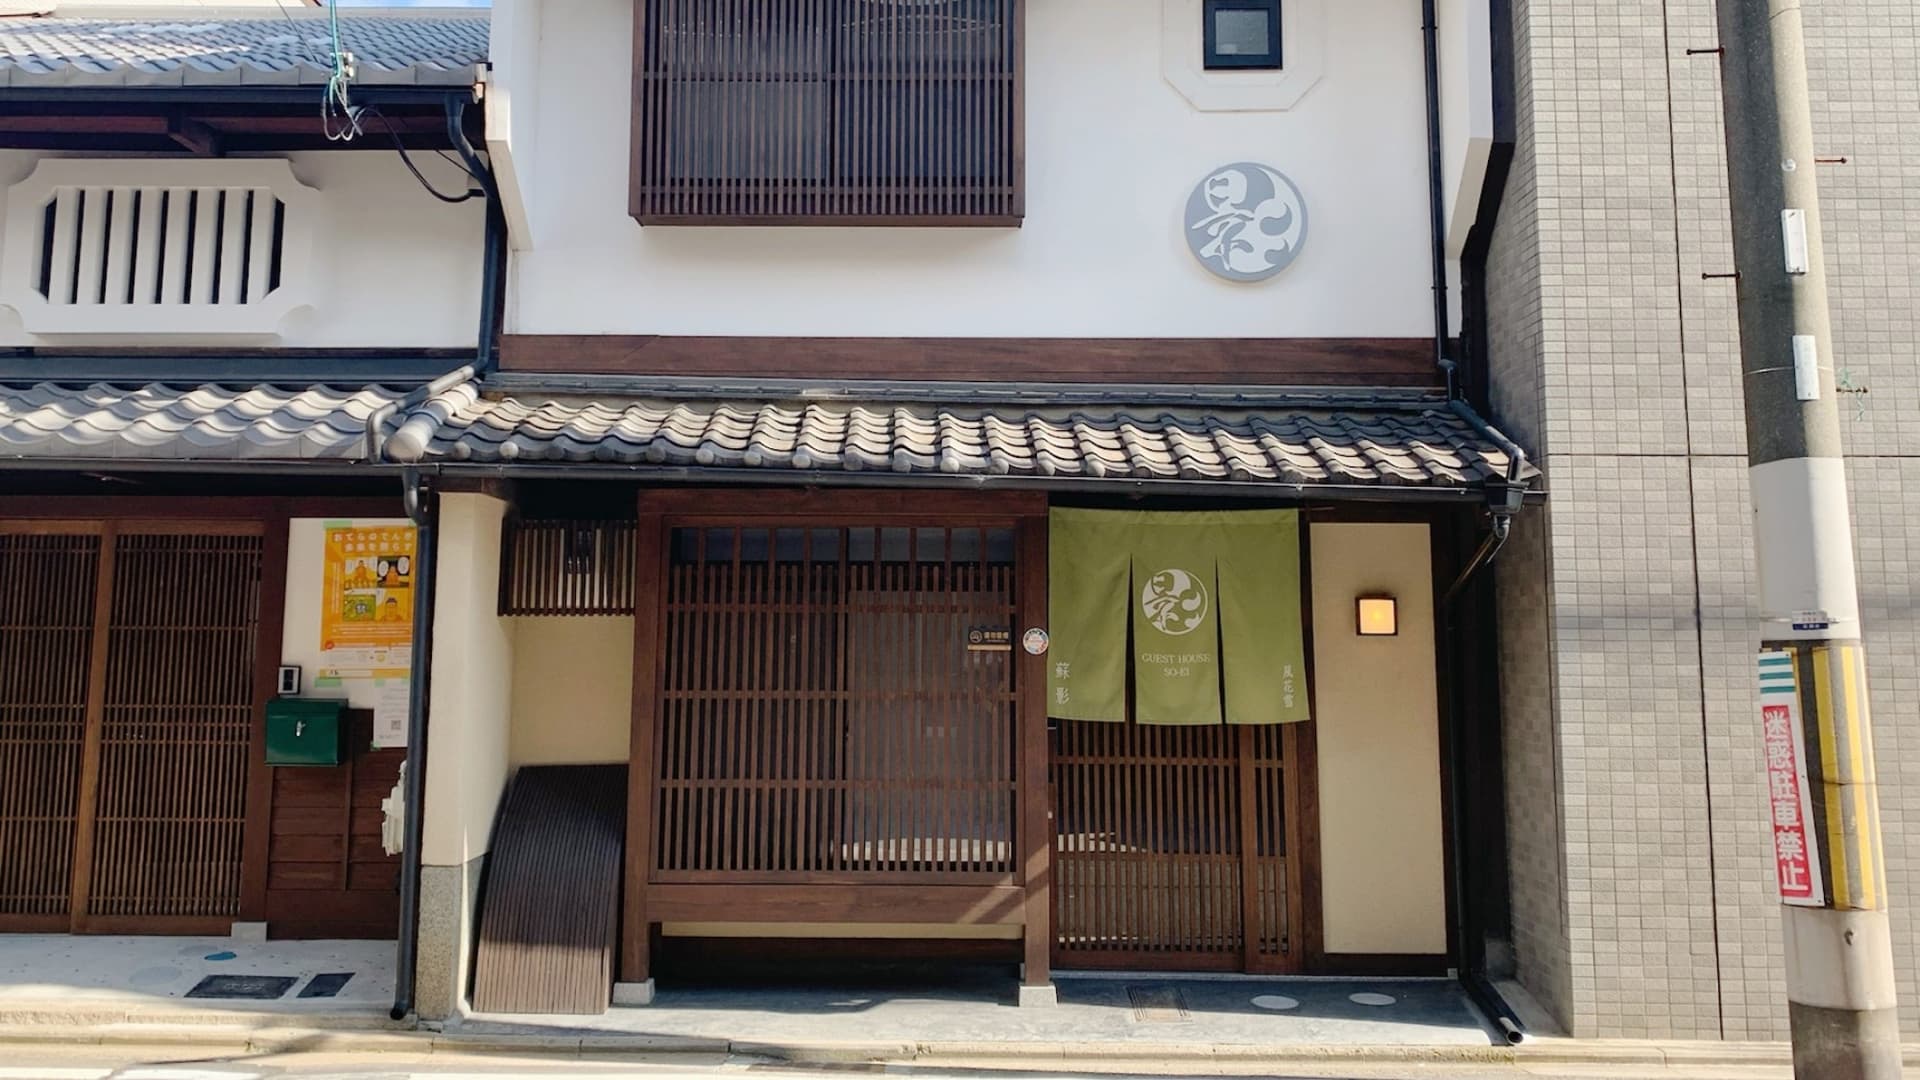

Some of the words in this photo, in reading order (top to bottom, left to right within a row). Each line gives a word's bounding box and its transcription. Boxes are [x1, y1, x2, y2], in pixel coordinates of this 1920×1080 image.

[1142, 653, 1175, 664] GUEST
[1178, 653, 1211, 664] HOUSE
[1765, 710, 1809, 891] 迷惑駐車禁止
